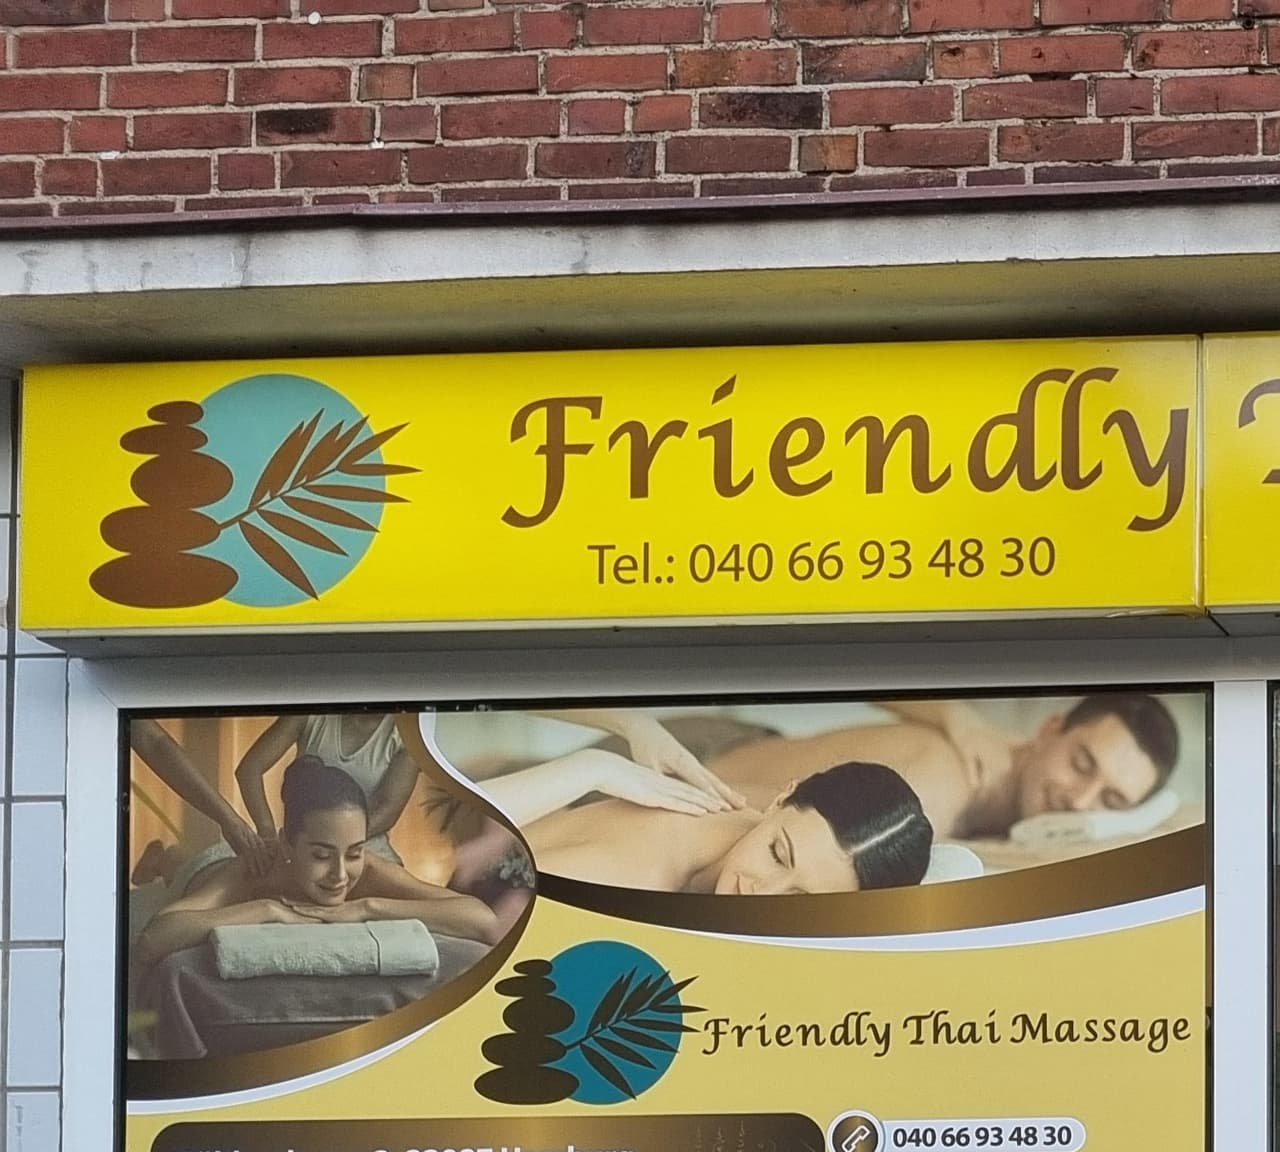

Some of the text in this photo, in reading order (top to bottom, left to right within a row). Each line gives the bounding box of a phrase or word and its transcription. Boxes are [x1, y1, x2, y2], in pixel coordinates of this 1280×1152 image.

[502, 367, 1188, 532] Friendly
[587, 537, 1055, 584] Tel.: 040 66 93 48 30
[702, 1010, 1190, 1057] Friendly Thai Massage
[893, 1126, 1071, 1147] 040 66 93 48 30
